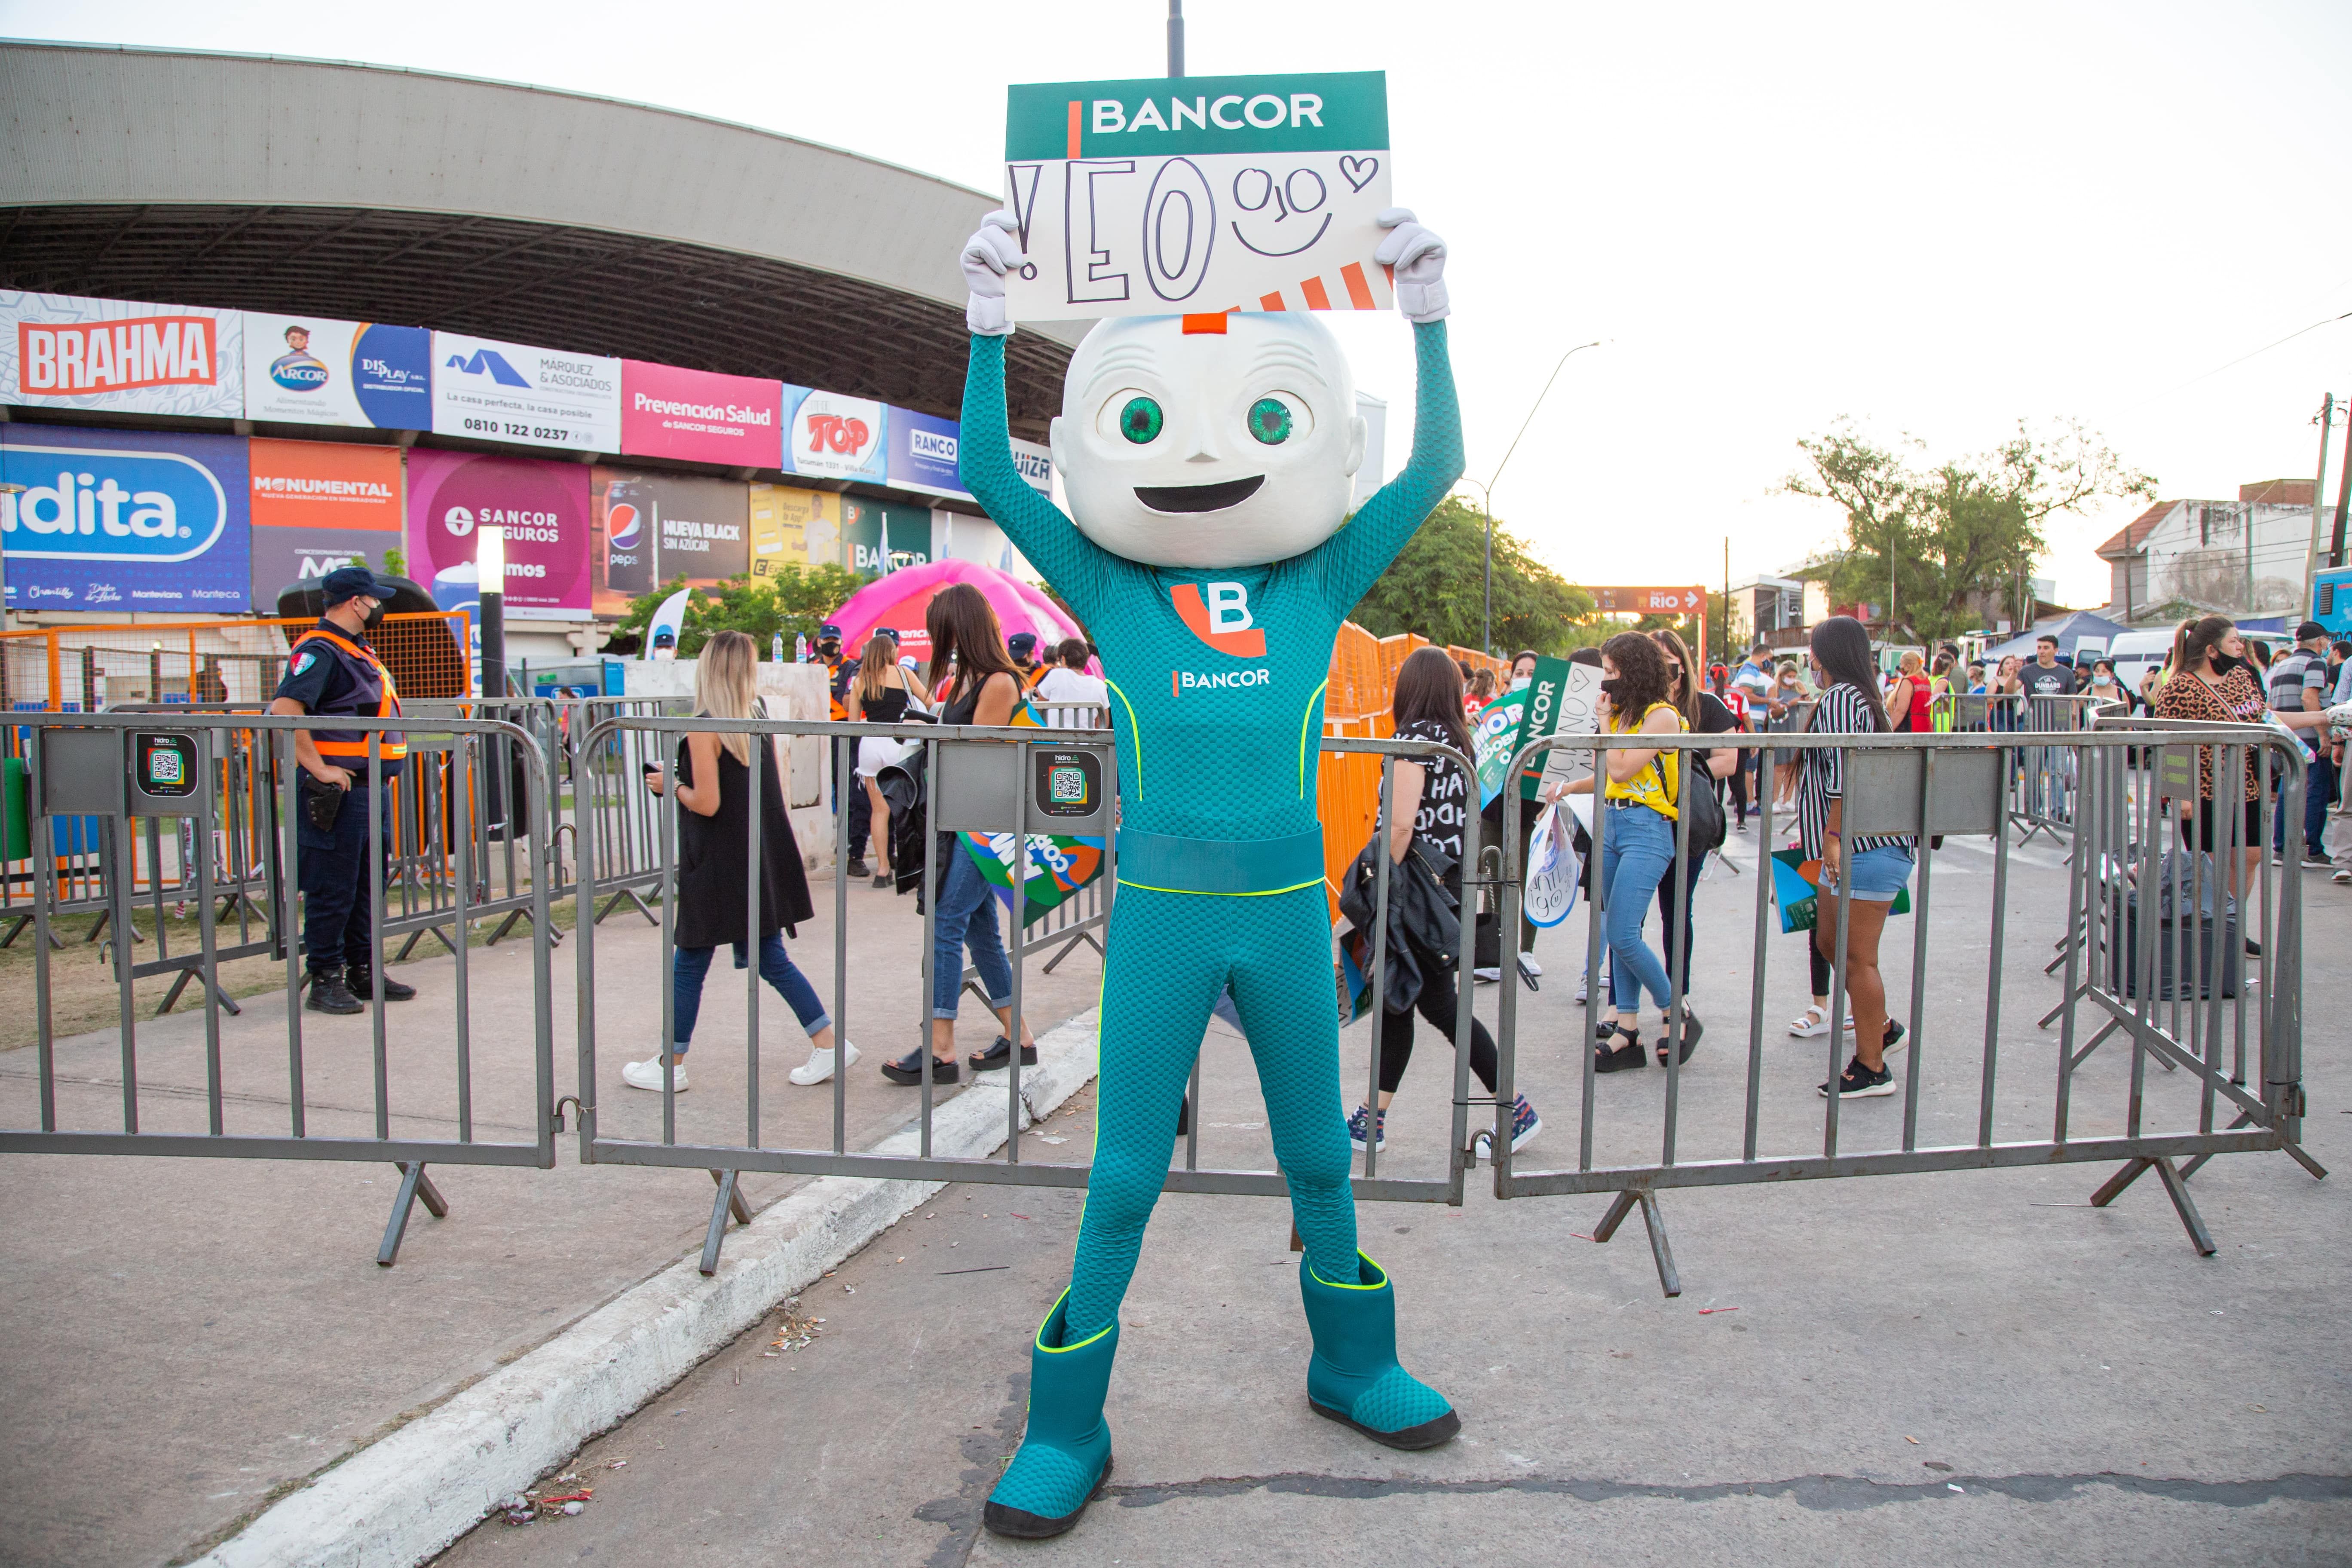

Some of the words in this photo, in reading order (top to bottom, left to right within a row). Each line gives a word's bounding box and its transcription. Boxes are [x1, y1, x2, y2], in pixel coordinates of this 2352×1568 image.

[1092, 94, 1324, 133] BANCOR
[28, 322, 210, 389] BRAHMA
[273, 364, 327, 382] ARCOR
[362, 358, 411, 383] DISPLAY
[540, 358, 593, 376] MÁRQUEZ
[540, 372, 549, 383] &
[551, 373, 612, 392] ASOCIADOS
[447, 392, 458, 401] La
[461, 395, 483, 405] casa
[484, 398, 525, 411] perfecta,
[537, 406, 558, 414] casa
[560, 407, 592, 420] posible
[635, 392, 725, 420] Prevención
[726, 405, 771, 426] Salud
[465, 418, 498, 432] 0810
[505, 423, 529, 436] 122
[535, 427, 568, 441] 0237
[662, 420, 673, 428] de
[673, 421, 707, 432] SANCOR
[707, 425, 745, 436] SEGUROS
[807, 413, 869, 456] TOP
[915, 434, 955, 456] RANCO
[1015, 452, 1050, 480] UIZA
[254, 477, 393, 497] MONUMENTAL
[480, 508, 558, 527] SANCOR
[503, 526, 559, 543] GUROS
[663, 520, 703, 537] NUEVA
[703, 523, 740, 540] BLACK
[663, 537, 677, 550] SIN
[678, 537, 710, 551] AZÚCAR
[505, 563, 546, 578] mos
[192, 589, 241, 599] Manteca
[1650, 596, 1678, 608] RIO
[1207, 582, 1253, 634] B
[1182, 669, 1270, 688] BANCOR
[1526, 680, 1556, 768] NCOR
[1538, 697, 1588, 798] UCINO
